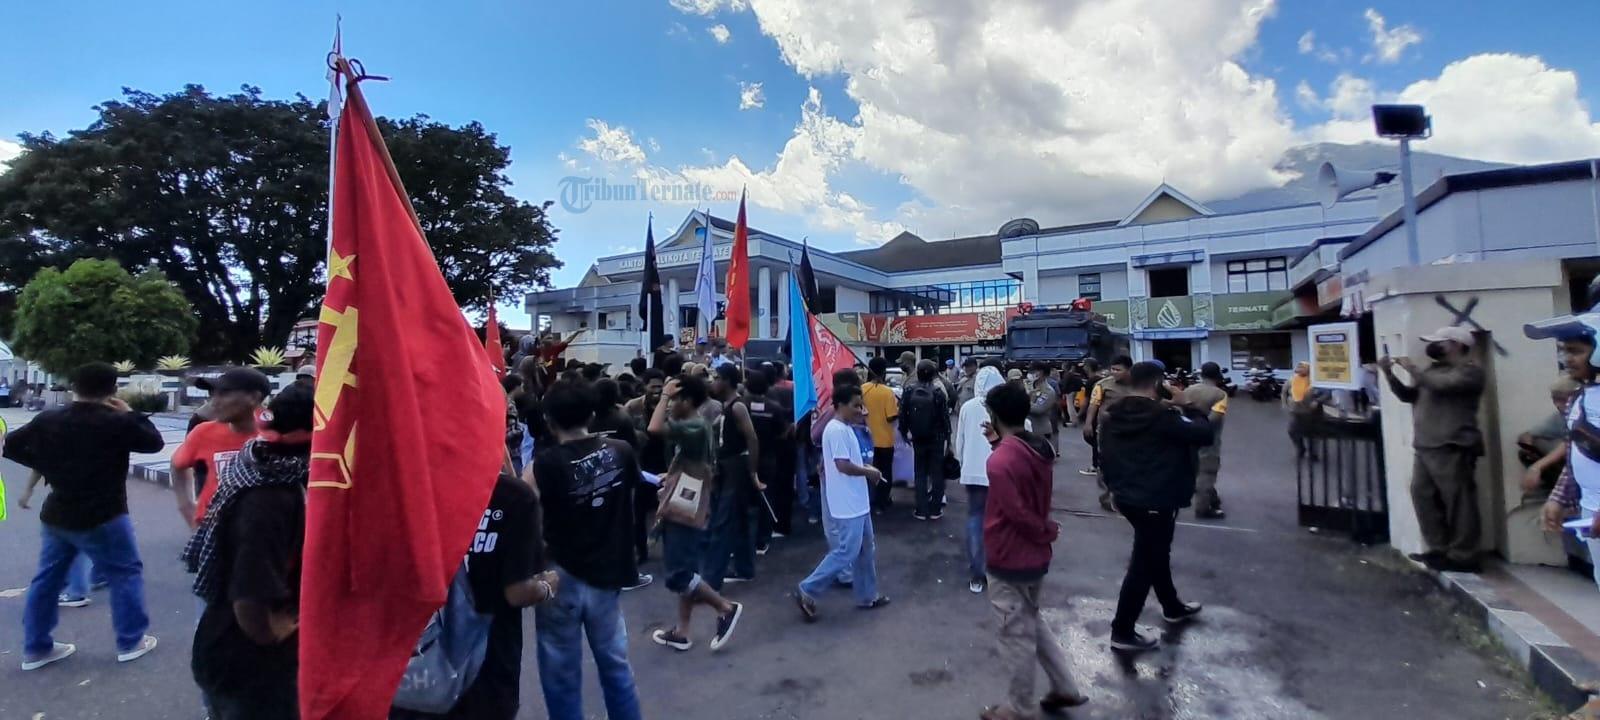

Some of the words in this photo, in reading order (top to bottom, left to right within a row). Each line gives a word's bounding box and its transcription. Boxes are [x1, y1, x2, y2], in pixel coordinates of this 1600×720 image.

[620, 256, 645, 269] KANTO
[655, 249, 688, 265] ALIKOTA
[1227, 304, 1270, 313] TERNATE
